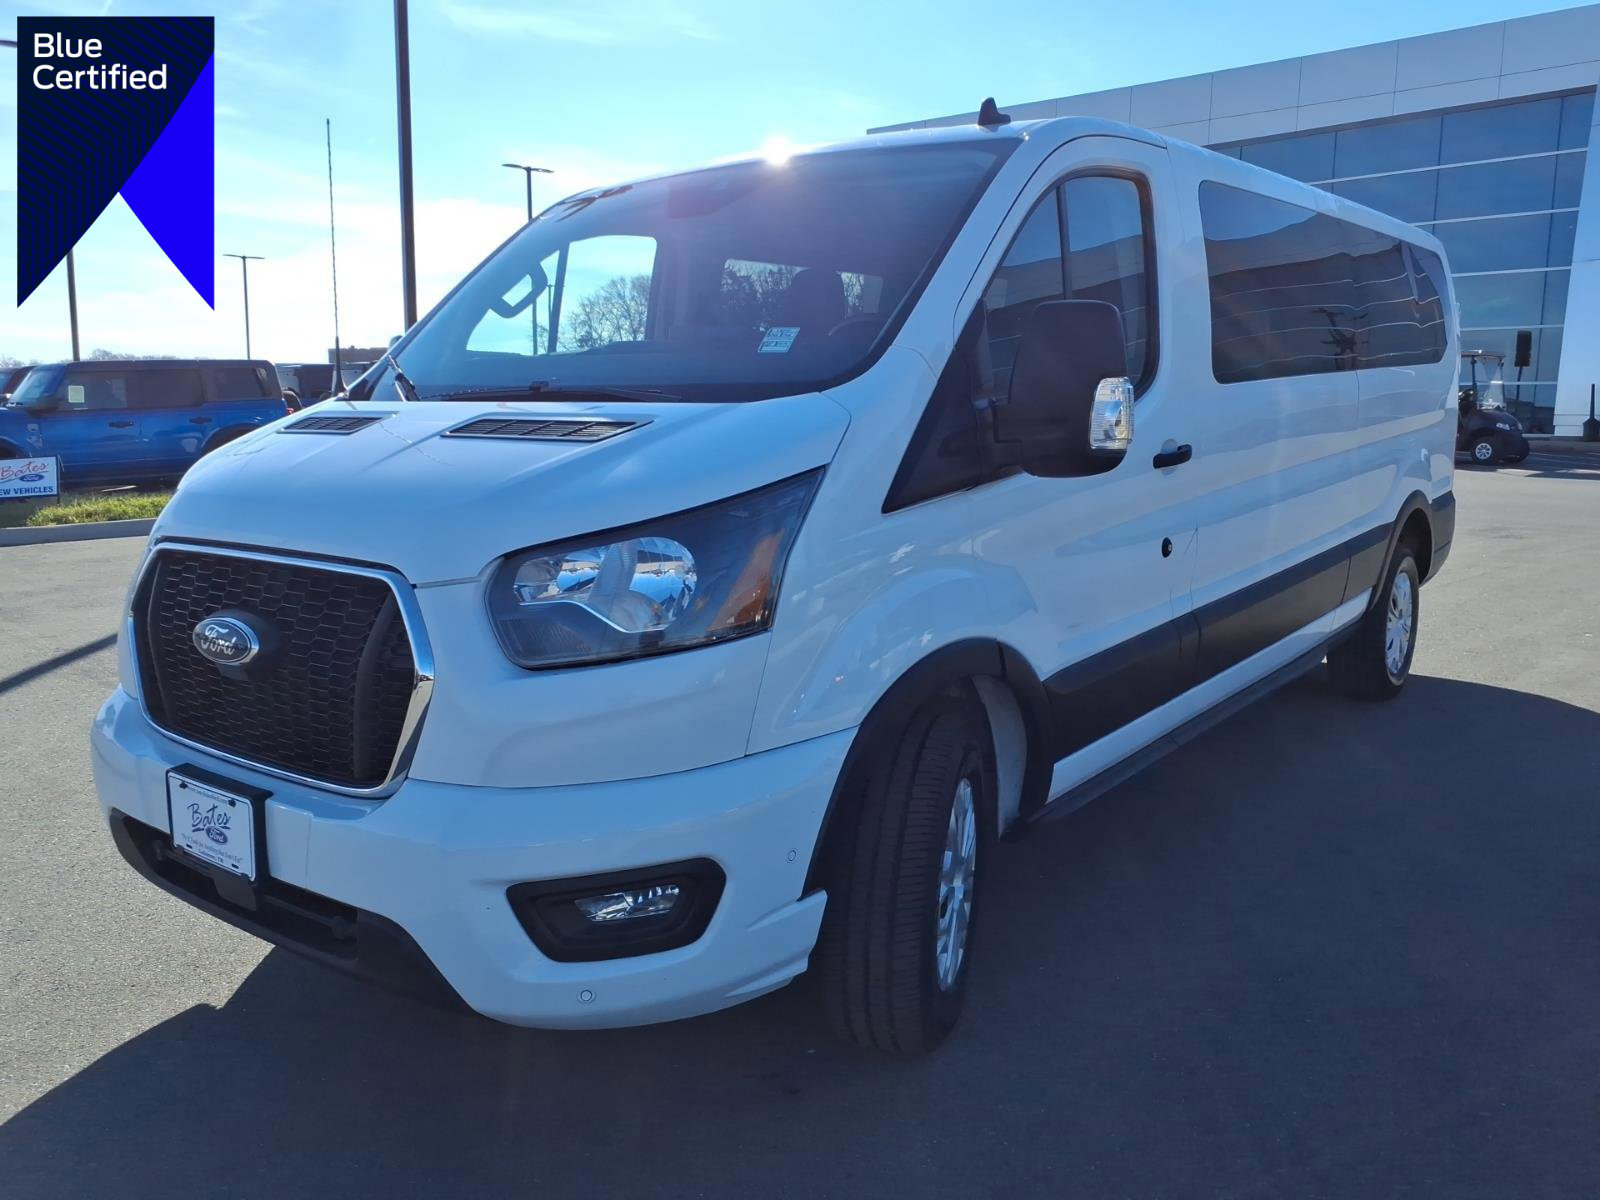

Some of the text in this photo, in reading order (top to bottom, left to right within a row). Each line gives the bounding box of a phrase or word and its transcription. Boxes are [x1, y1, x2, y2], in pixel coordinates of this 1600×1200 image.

[0, 461, 49, 478] Bates
[0, 486, 54, 496] EW VEHICLES
[186, 803, 232, 829] Bates
